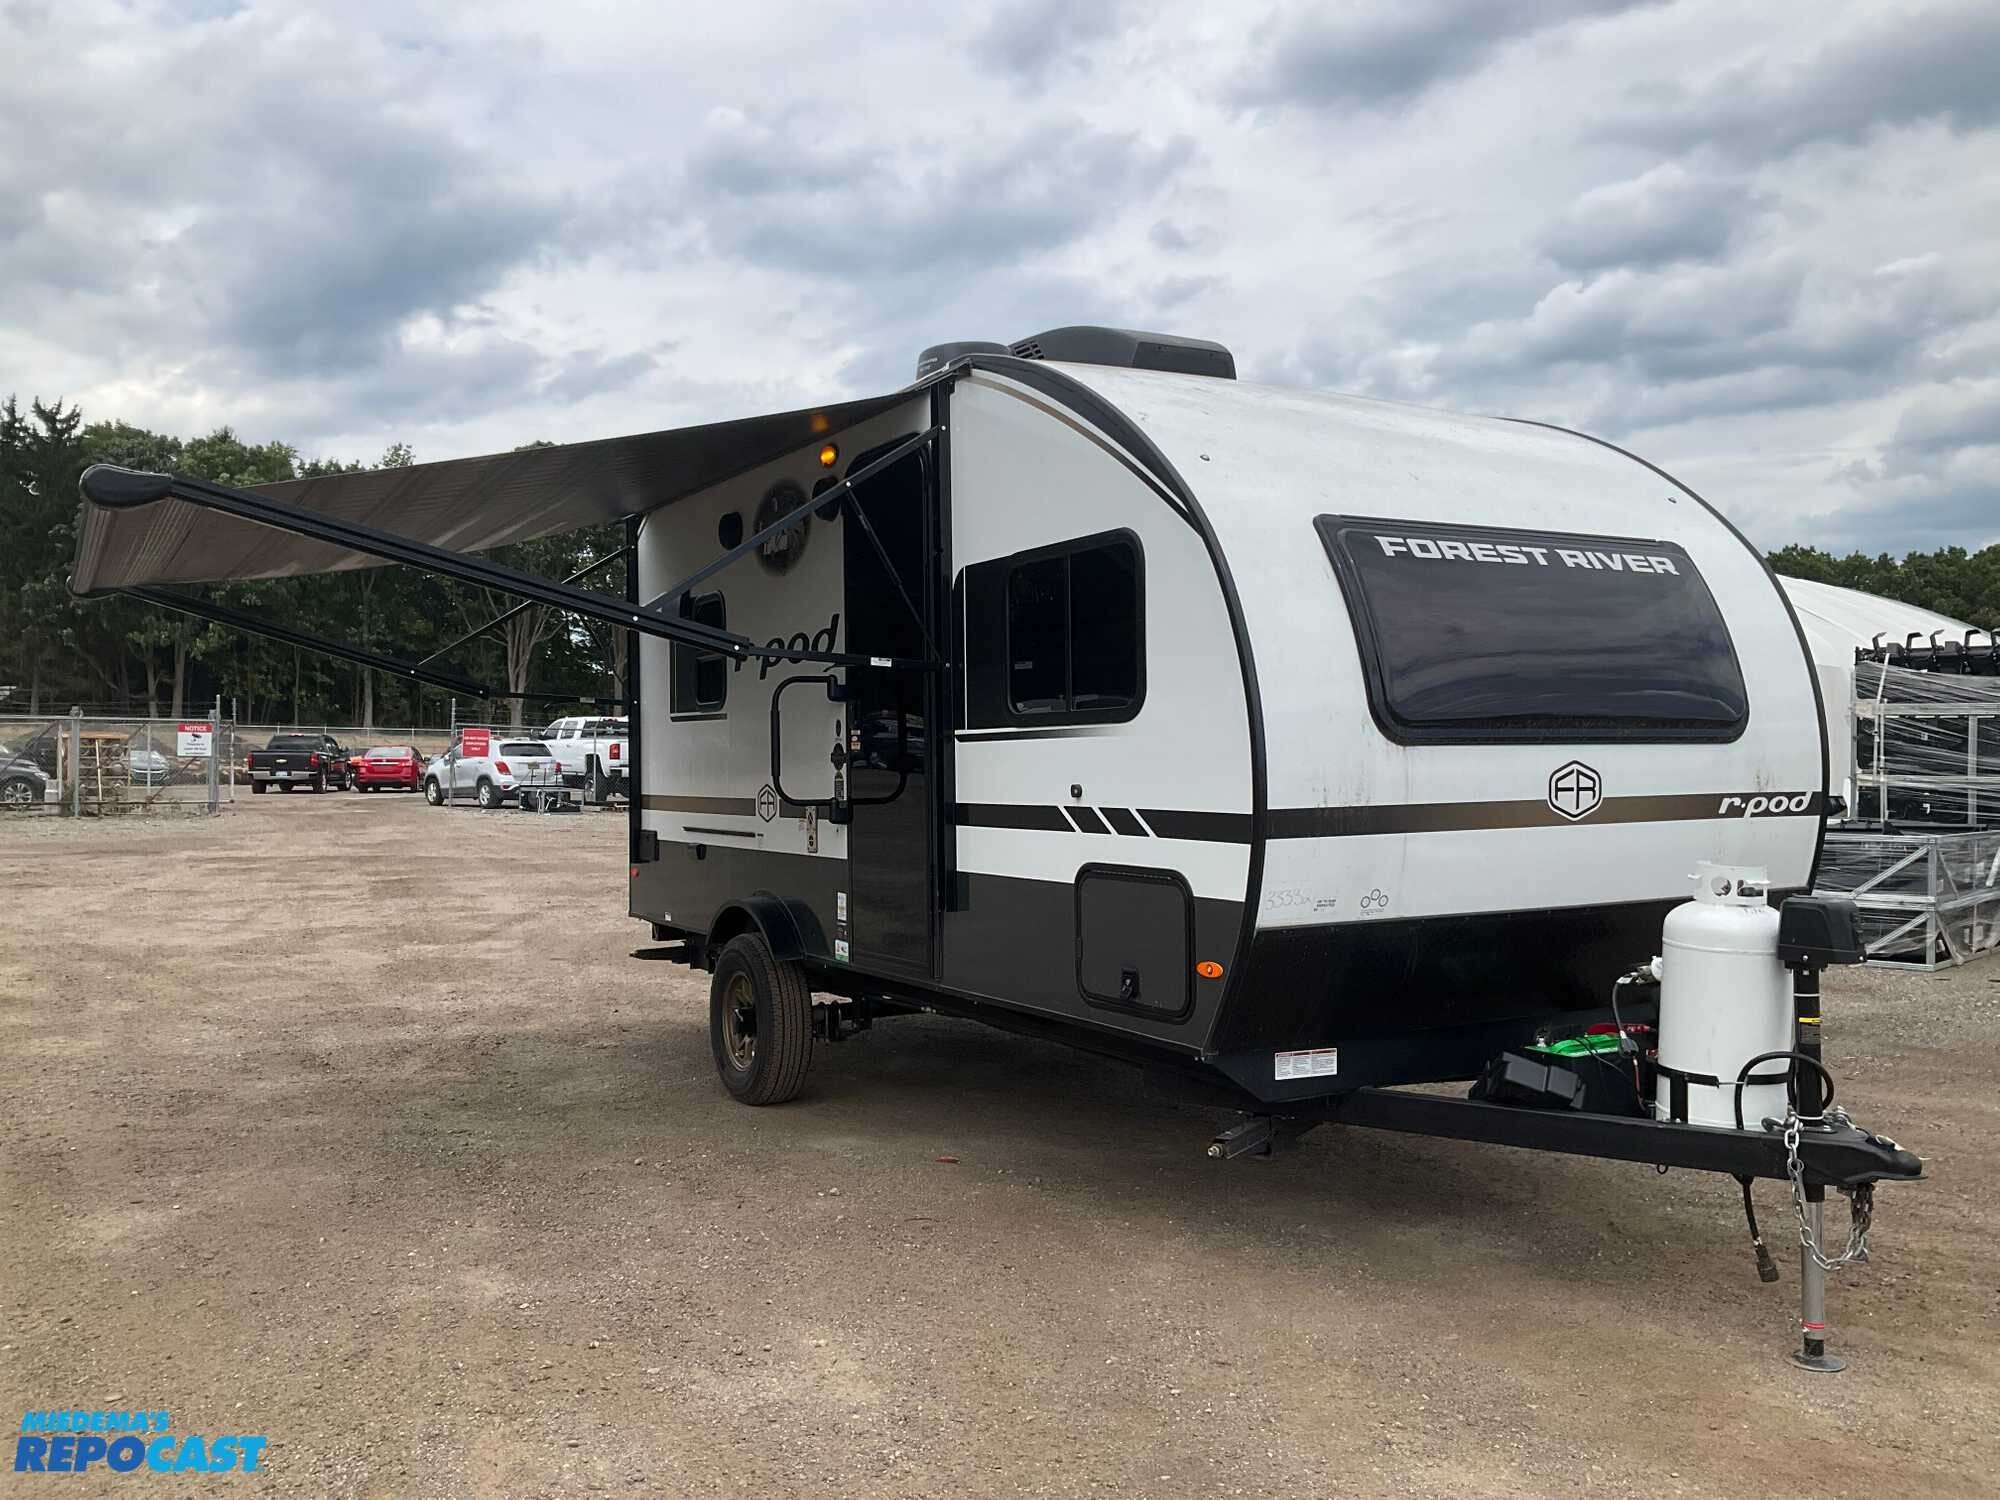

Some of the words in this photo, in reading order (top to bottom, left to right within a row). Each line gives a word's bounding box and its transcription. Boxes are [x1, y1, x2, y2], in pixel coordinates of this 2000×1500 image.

[1374, 535, 1549, 566] FOREST
[1555, 548, 1680, 576] RIVER
[184, 724, 208, 732] NOTICE
